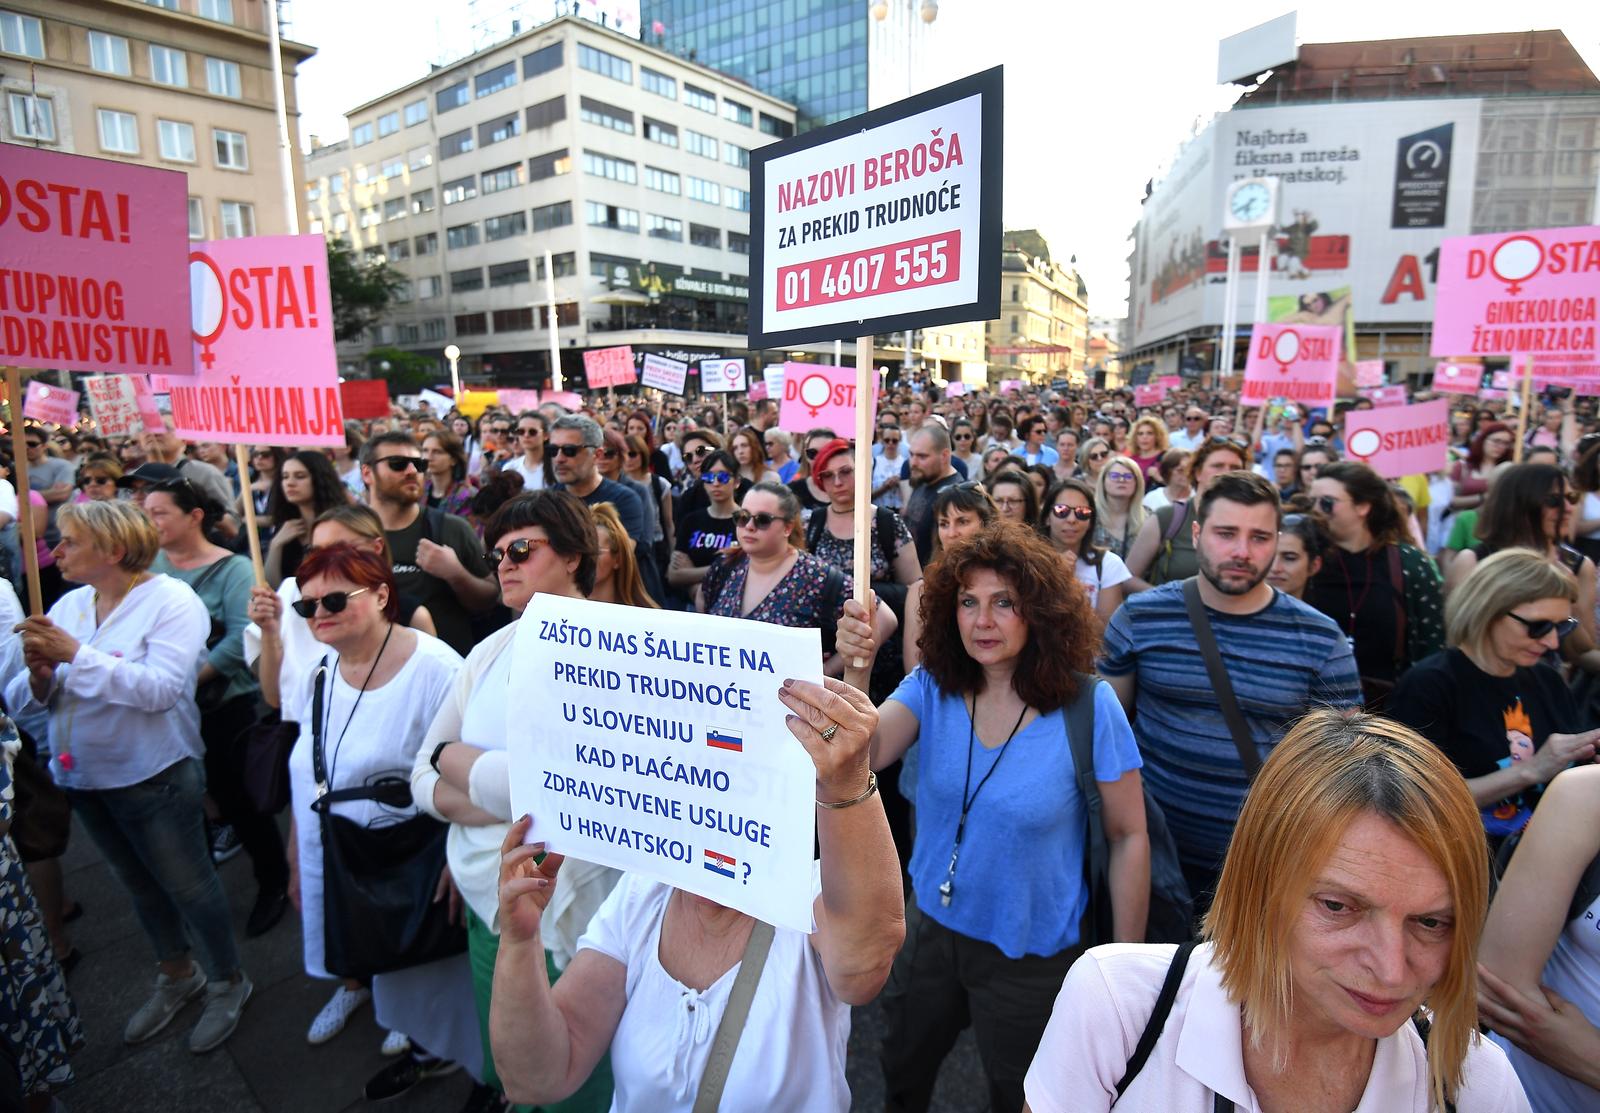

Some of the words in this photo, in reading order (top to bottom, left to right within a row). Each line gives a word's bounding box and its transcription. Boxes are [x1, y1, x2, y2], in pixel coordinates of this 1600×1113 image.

[1234, 149, 1294, 166] fiksna
[1300, 144, 1360, 163] mreža
[1236, 128, 1308, 149] Najbrža
[778, 163, 855, 213] NAZOVI
[864, 127, 963, 191] BEROŠA
[0, 175, 131, 243] STA!
[778, 225, 797, 249] ZA
[802, 210, 860, 244] PREKID
[865, 180, 961, 229] TRUDNOĆE
[784, 269, 811, 304] 01
[821, 253, 886, 297] 4607
[894, 240, 948, 286] 555
[1380, 247, 1440, 304] A1
[1486, 297, 1596, 324] GINEKOLOGA
[0, 315, 172, 366] DRAVSTVA
[1471, 324, 1596, 353] ŽENOMRZACA
[539, 619, 592, 648] ZAŠTO
[598, 630, 638, 655] NAS
[644, 631, 732, 668] ŠALJETE
[739, 649, 775, 674] NA
[554, 661, 621, 691] PREKID
[626, 673, 751, 711] TRUDNOĆE
[563, 702, 577, 722] U
[583, 706, 693, 744] SLOVENIJU
[576, 743, 616, 769] KAD
[622, 753, 730, 792] PLAĆAMO
[542, 770, 681, 821] ZDRAVSTVENE
[689, 803, 771, 848] USLUGE
[560, 812, 572, 831] U
[578, 818, 693, 864] HRVATSKOJ
[742, 862, 752, 885] ?
